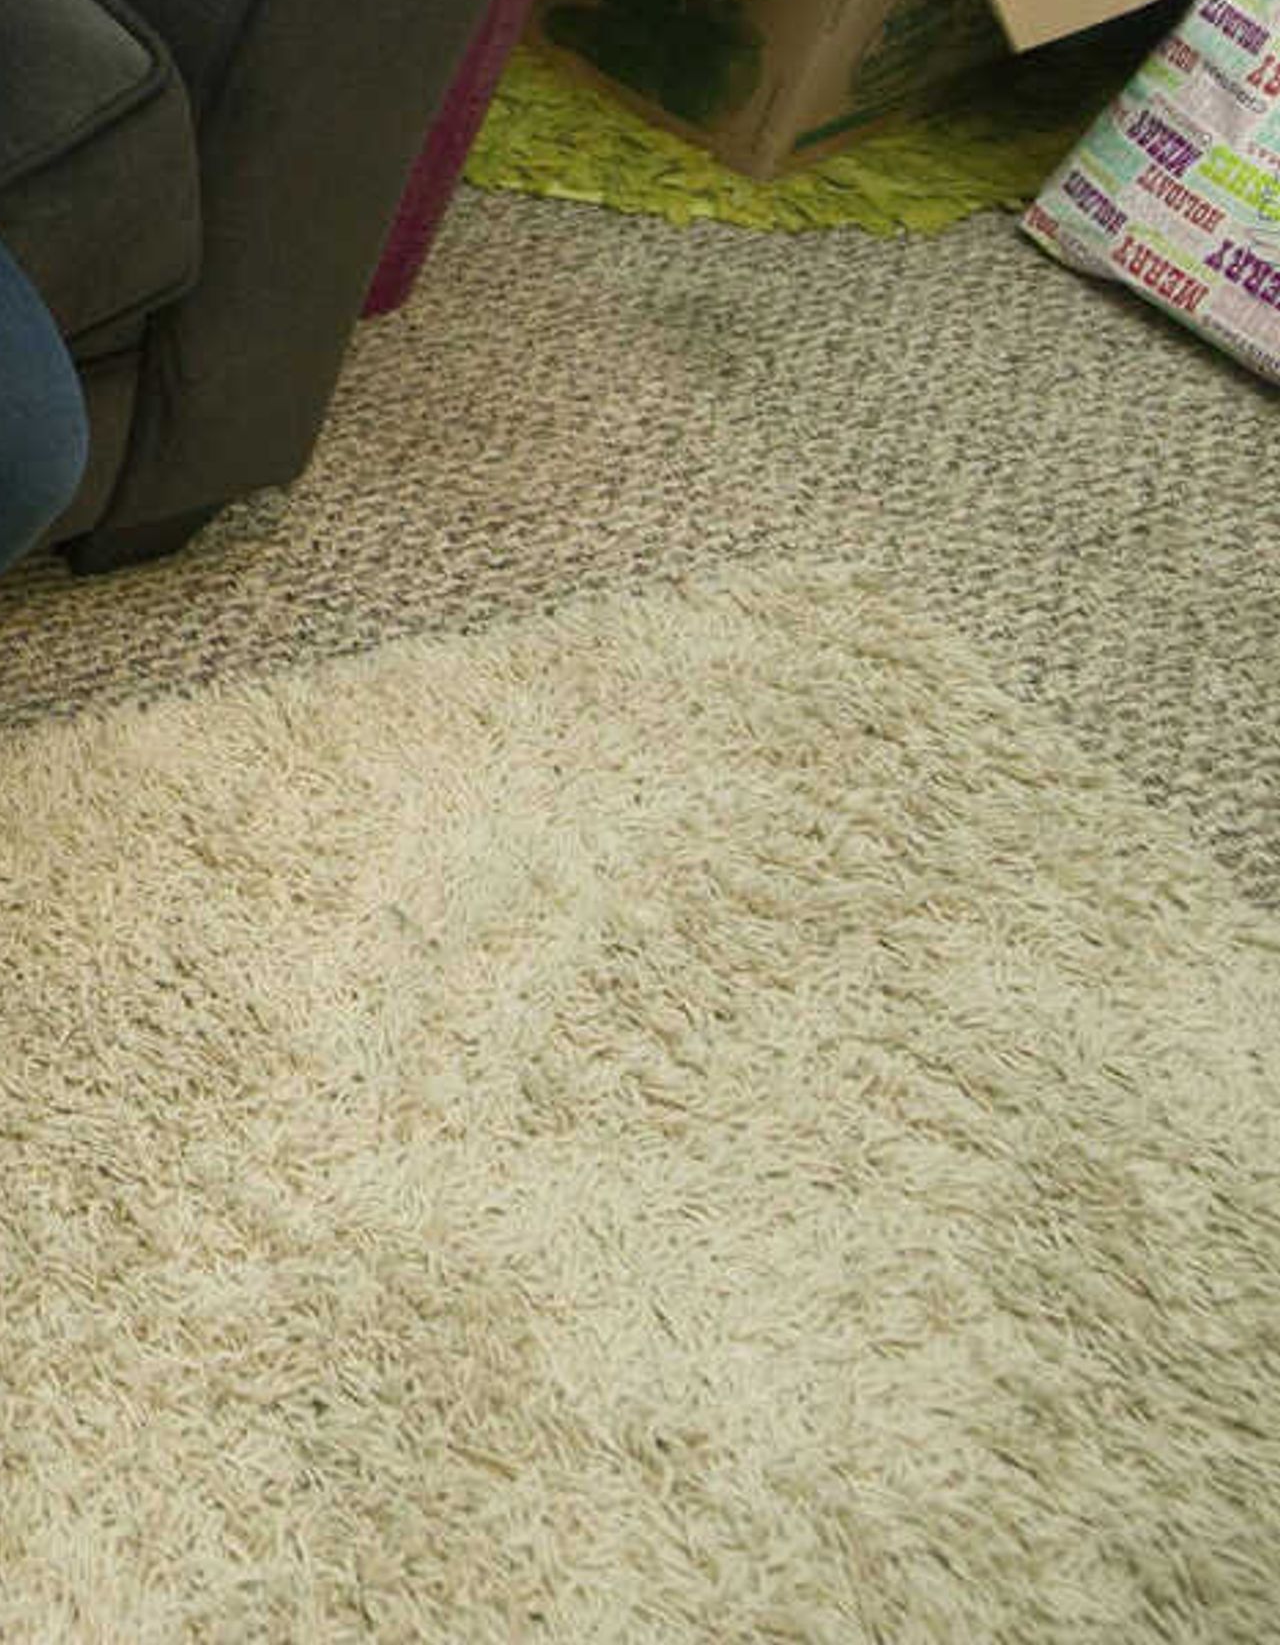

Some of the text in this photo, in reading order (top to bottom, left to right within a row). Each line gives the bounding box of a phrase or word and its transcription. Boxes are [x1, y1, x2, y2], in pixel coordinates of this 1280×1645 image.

[1136, 162, 1226, 233] HOLIDAY
[1111, 234, 1210, 314] MERRY
[1202, 238, 1280, 316] ERRY
